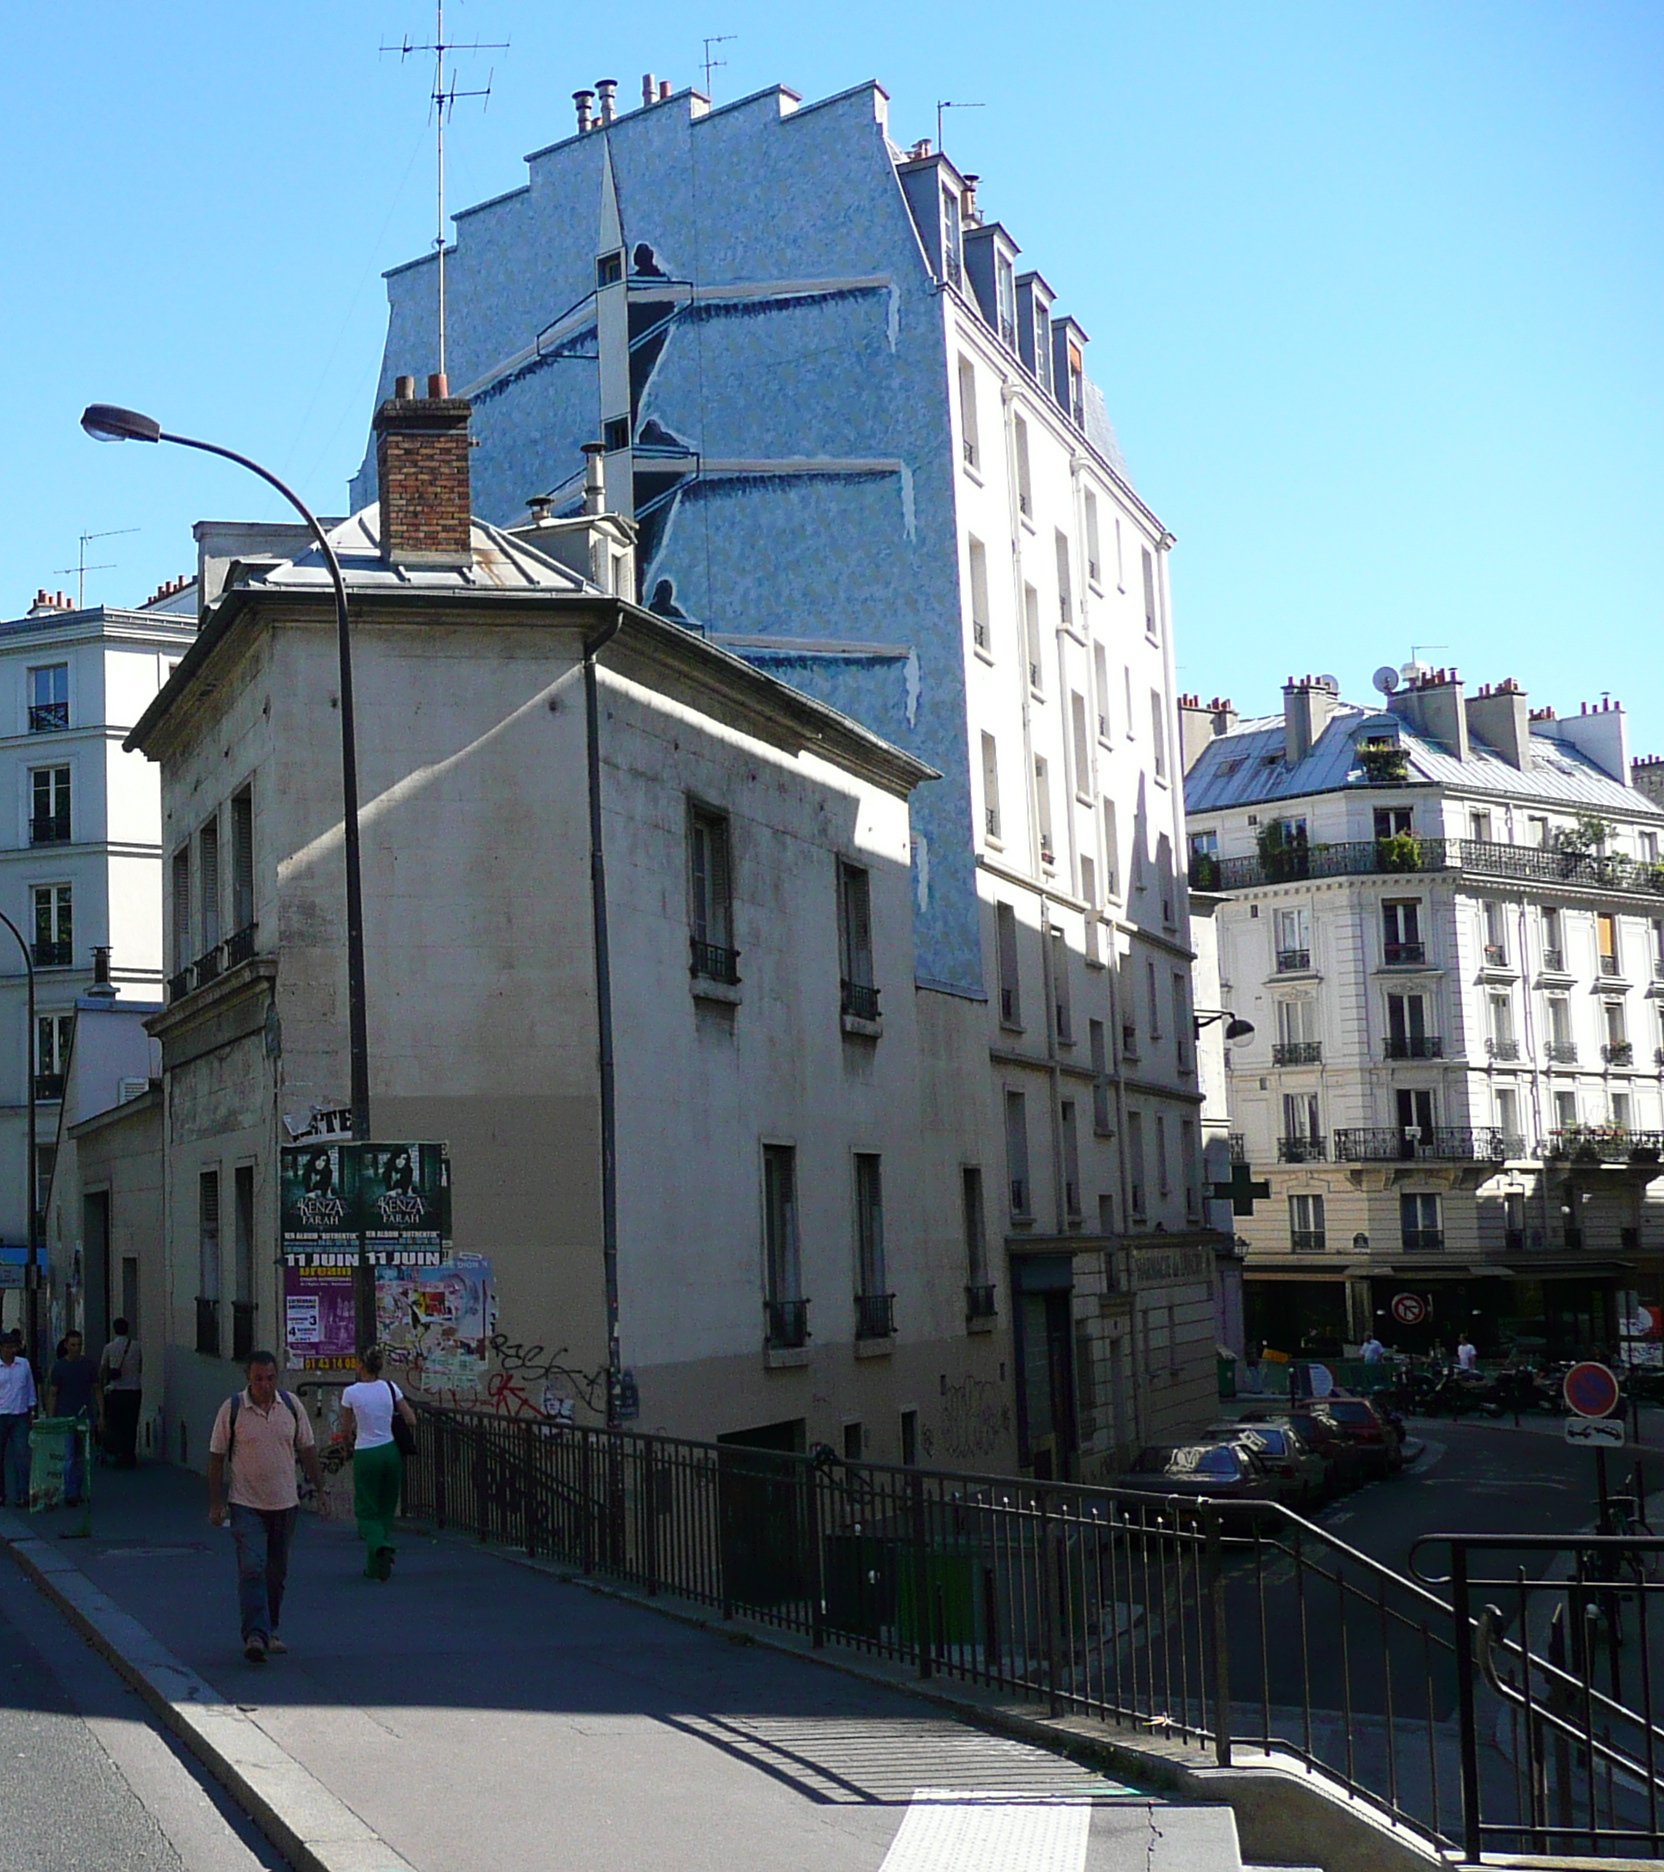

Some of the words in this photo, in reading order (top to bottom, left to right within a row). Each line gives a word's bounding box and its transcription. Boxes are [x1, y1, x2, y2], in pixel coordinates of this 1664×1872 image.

[297, 1198, 344, 1217] KENZA
[376, 1196, 425, 1215] KENZA
[302, 1215, 339, 1226] FARAH
[382, 1213, 420, 1224] FARAH
[284, 1253, 306, 1267] 11
[311, 1253, 360, 1267] JUIN
[365, 1251, 387, 1265] 11
[391, 1251, 440, 1265] JUIN
[309, 1315, 317, 1326] 3
[288, 1326, 296, 1337] 4
[305, 1358, 315, 1369] 01
